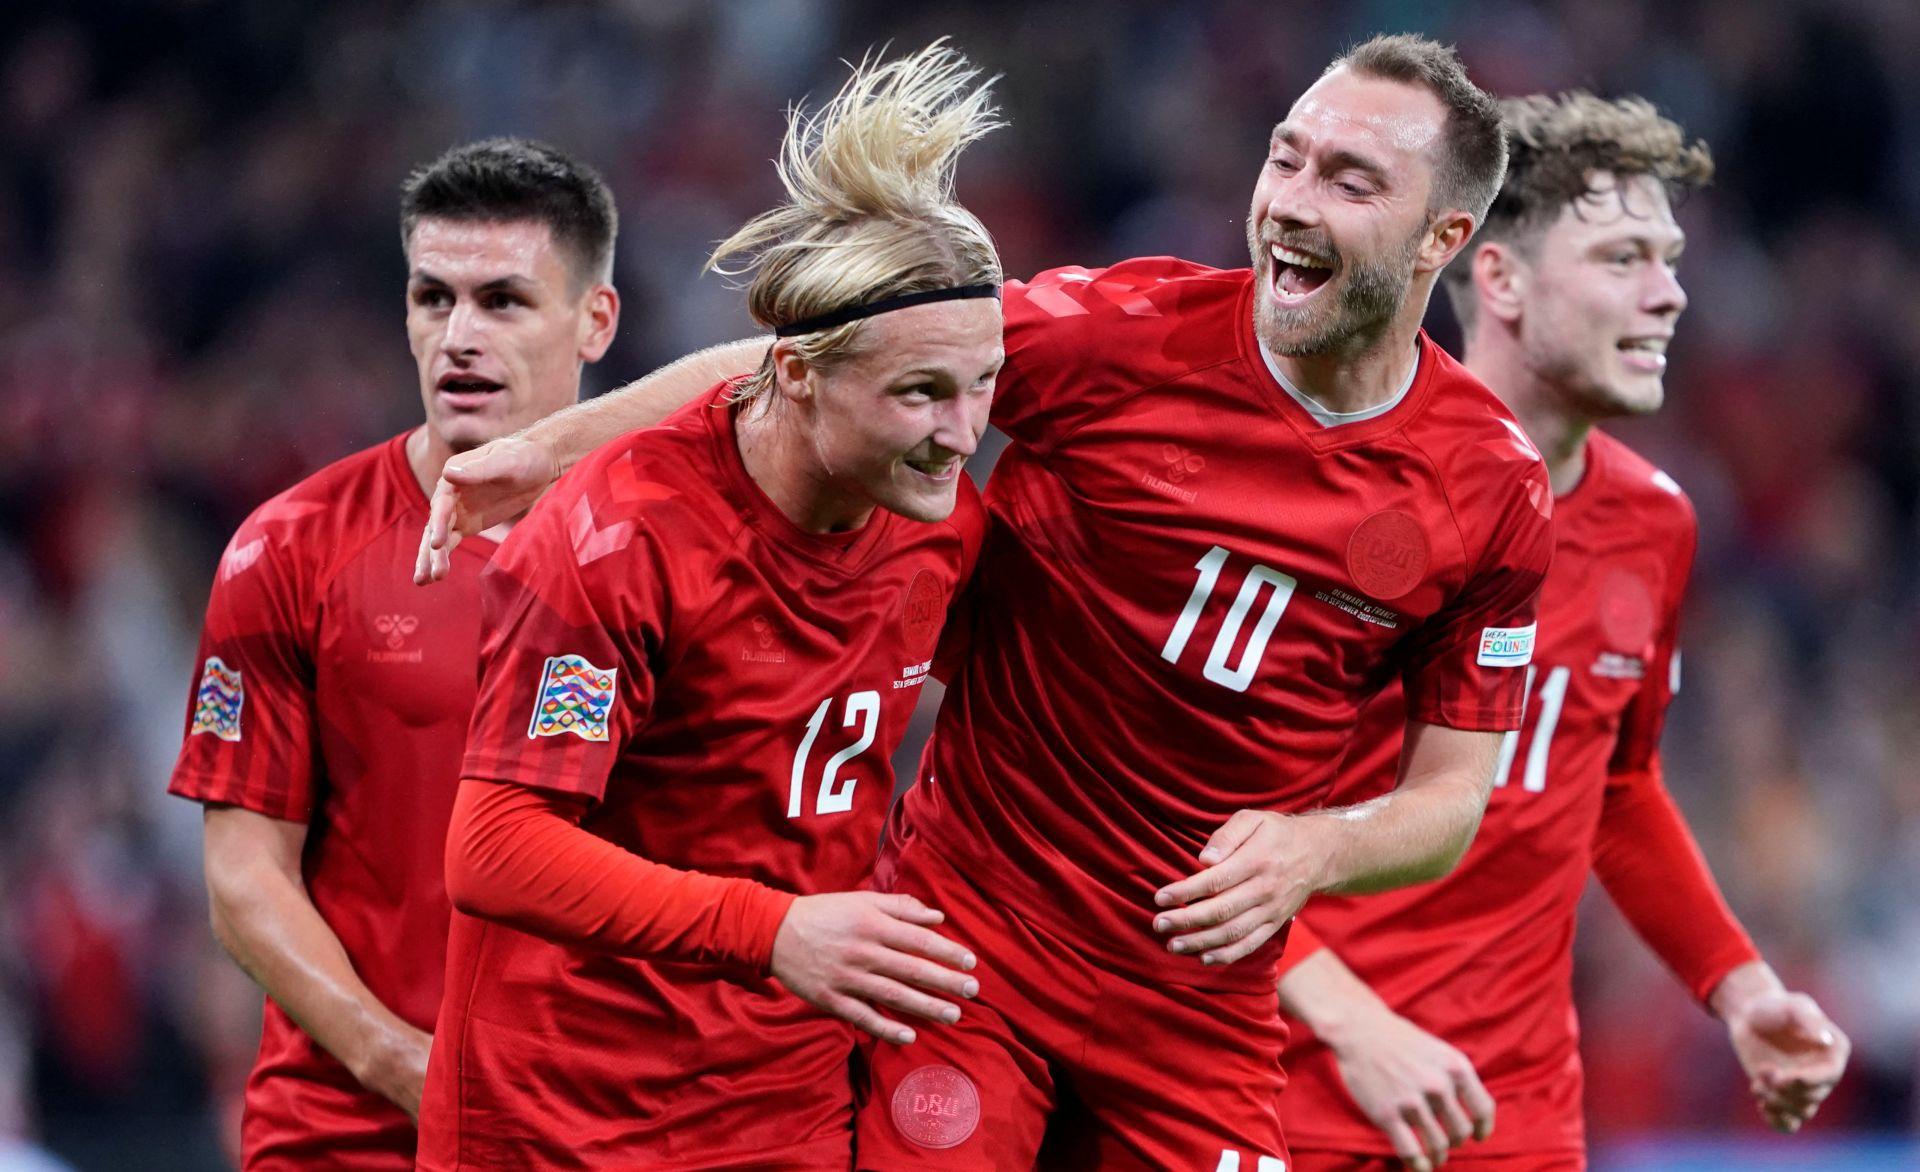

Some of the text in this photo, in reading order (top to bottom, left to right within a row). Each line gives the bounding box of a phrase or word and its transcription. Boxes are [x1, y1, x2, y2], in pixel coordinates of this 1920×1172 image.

[1142, 472, 1197, 503] hummel
[1332, 588, 1365, 607] DENMARK
[1160, 545, 1297, 693] 10
[1485, 630, 1507, 639] UEFA
[787, 690, 880, 818] 12
[913, 1093, 960, 1117] DBU
